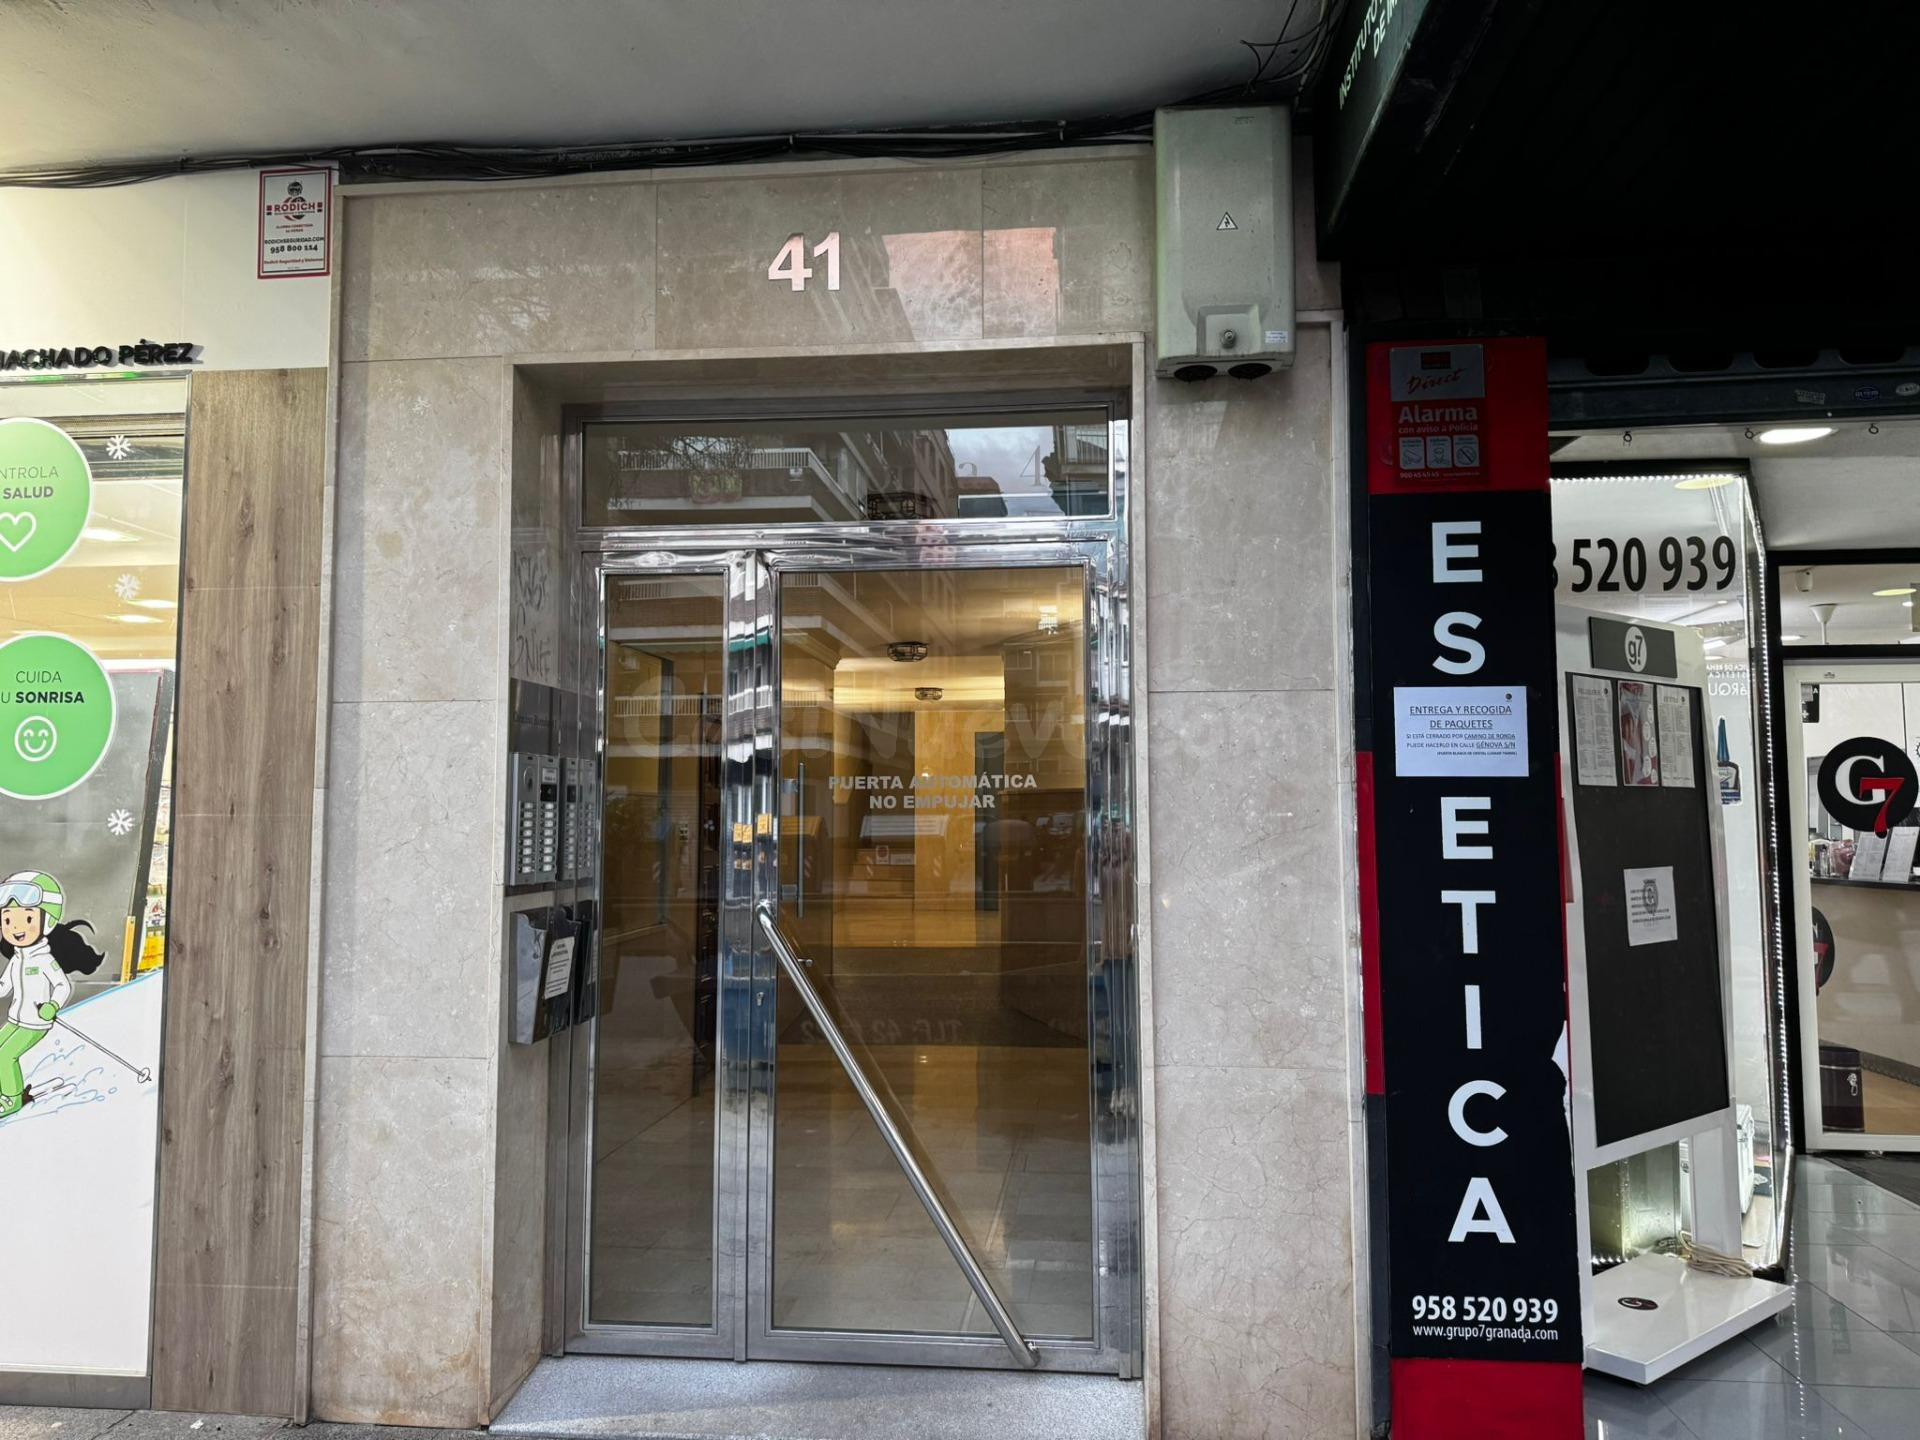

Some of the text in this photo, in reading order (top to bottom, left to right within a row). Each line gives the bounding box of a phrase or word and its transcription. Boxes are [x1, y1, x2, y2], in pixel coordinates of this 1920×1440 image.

[274, 203, 316, 212] RODICH
[270, 245, 285, 254] 958
[287, 244, 302, 252] 800
[767, 231, 840, 291] 41
[1398, 404, 1478, 424] Alarma
[3, 486, 54, 500] SALUD
[1571, 537, 1647, 593] 520
[1659, 536, 1736, 592] 939
[15, 670, 63, 684] CUIDA
[15, 691, 85, 704] SONRISA
[1409, 704, 1512, 715] ENTREGA Y RECOGIDA
[1430, 719, 1494, 729] DE PAQUETES
[1476, 740, 1503, 749] GÉNOVA
[1504, 741, 1516, 749] S/N
[829, 772, 1038, 791] PUERTA AUTOMÁTICA
[869, 795, 996, 809] NO EMPUJAR
[1835, 755, 1905, 839] G7
[1431, 520, 1517, 1244] ESETICA
[1412, 1295, 1559, 1323] 958 520 939
[1412, 1324, 1559, 1342] www.grupo7granada.com
